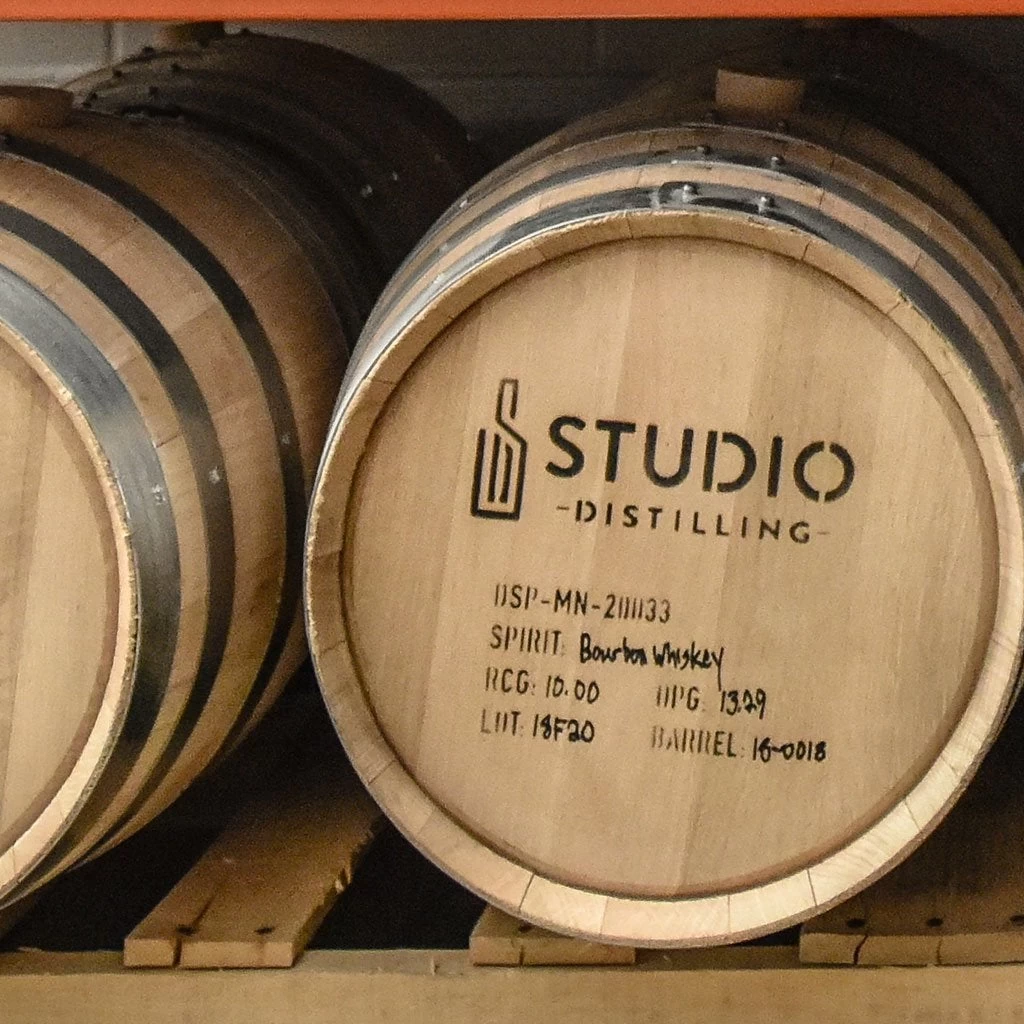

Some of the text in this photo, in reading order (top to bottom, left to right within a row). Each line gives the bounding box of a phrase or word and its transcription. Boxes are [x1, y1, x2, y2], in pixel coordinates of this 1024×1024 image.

[544, 415, 856, 503] STUDIO
[579, 632, 648, 666] Bourbon
[652, 641, 725, 692] Whiskey
[545, 675, 600, 704] 10.00
[532, 713, 595, 744] 18F20
